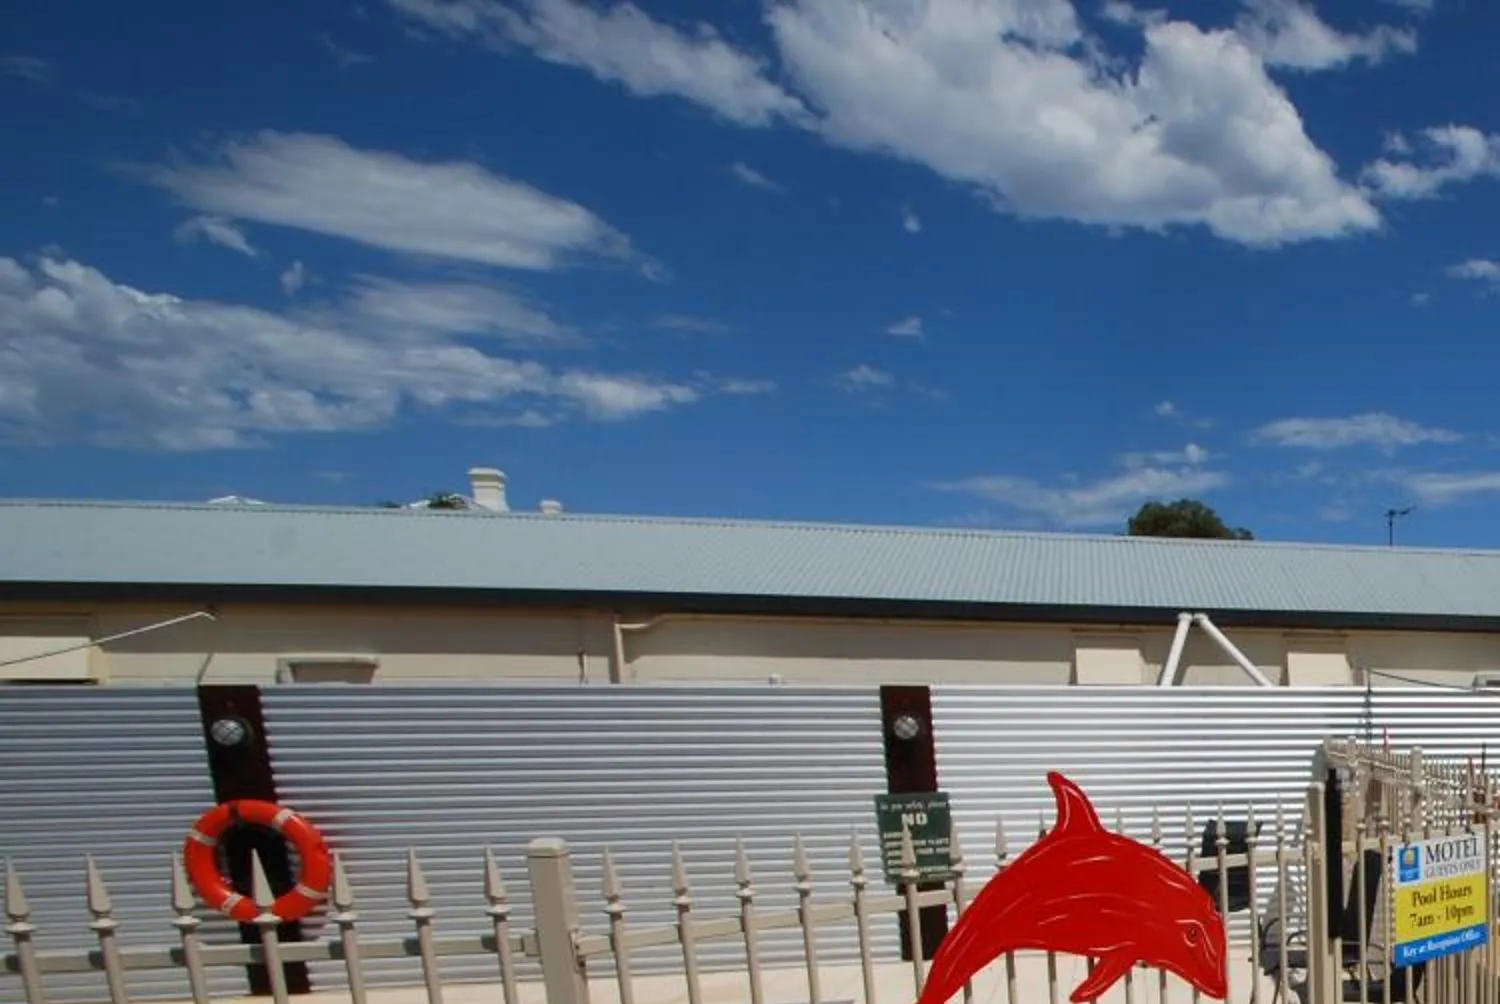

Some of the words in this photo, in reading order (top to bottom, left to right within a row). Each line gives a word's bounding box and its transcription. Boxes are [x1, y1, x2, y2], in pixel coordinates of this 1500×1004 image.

[901, 813, 928, 826] NO
[1425, 838, 1479, 864] MOTEL
[1411, 887, 1437, 907] Pool
[1440, 884, 1473, 901] Hours
[1409, 912, 1434, 928] 7am
[1446, 904, 1474, 924] 10pm
